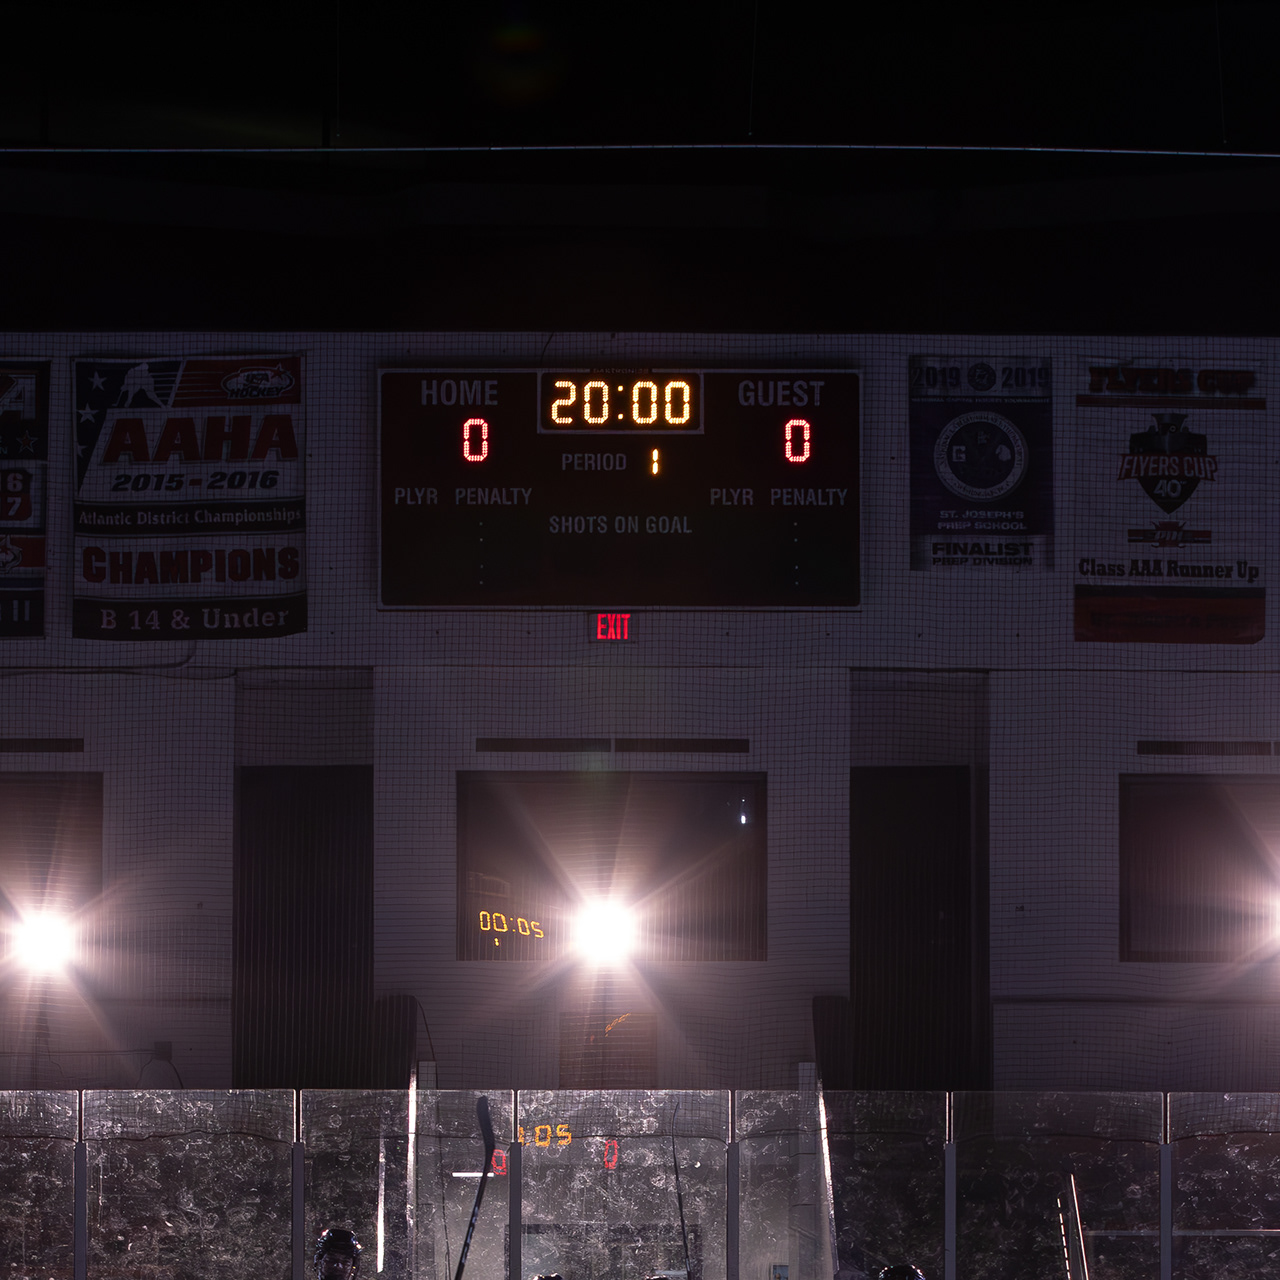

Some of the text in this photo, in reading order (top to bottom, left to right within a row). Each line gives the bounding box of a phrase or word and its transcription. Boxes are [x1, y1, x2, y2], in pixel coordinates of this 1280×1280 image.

[911, 366, 961, 387] 2019
[1002, 367, 1050, 388] 2019
[1089, 367, 1194, 393] FLYERS
[228, 387, 283, 398] HOCKEY
[421, 380, 498, 406] HOME
[552, 381, 690, 424] 20:00
[738, 380, 824, 406] GUEST
[100, 414, 298, 463] AAHA
[463, 418, 488, 461] 0
[785, 419, 810, 462] 0
[562, 454, 627, 471] PERIOD
[651, 448, 659, 475] 1
[1120, 456, 1216, 480] FLYERS CUP
[112, 471, 279, 491] 2015-2016
[1152, 479, 1186, 498] 40
[394, 488, 532, 505] PLYR PENALTY
[710, 489, 848, 506] PLYR PENALTY
[79, 508, 302, 526] Atlantic District Championships
[549, 516, 693, 534] SHOTS ON GOAL
[939, 510, 1024, 519] ST. JOSEPH'S
[974, 522, 1028, 530] SCHOOL
[932, 543, 1034, 555] FINALIST
[82, 547, 300, 584] CHAMPIONS
[933, 557, 1032, 565] PREP DIVISION
[1079, 559, 1259, 583] Class AAA Runner Up
[100, 608, 289, 630] B 14 & Under
[597, 614, 630, 640] EXIT
